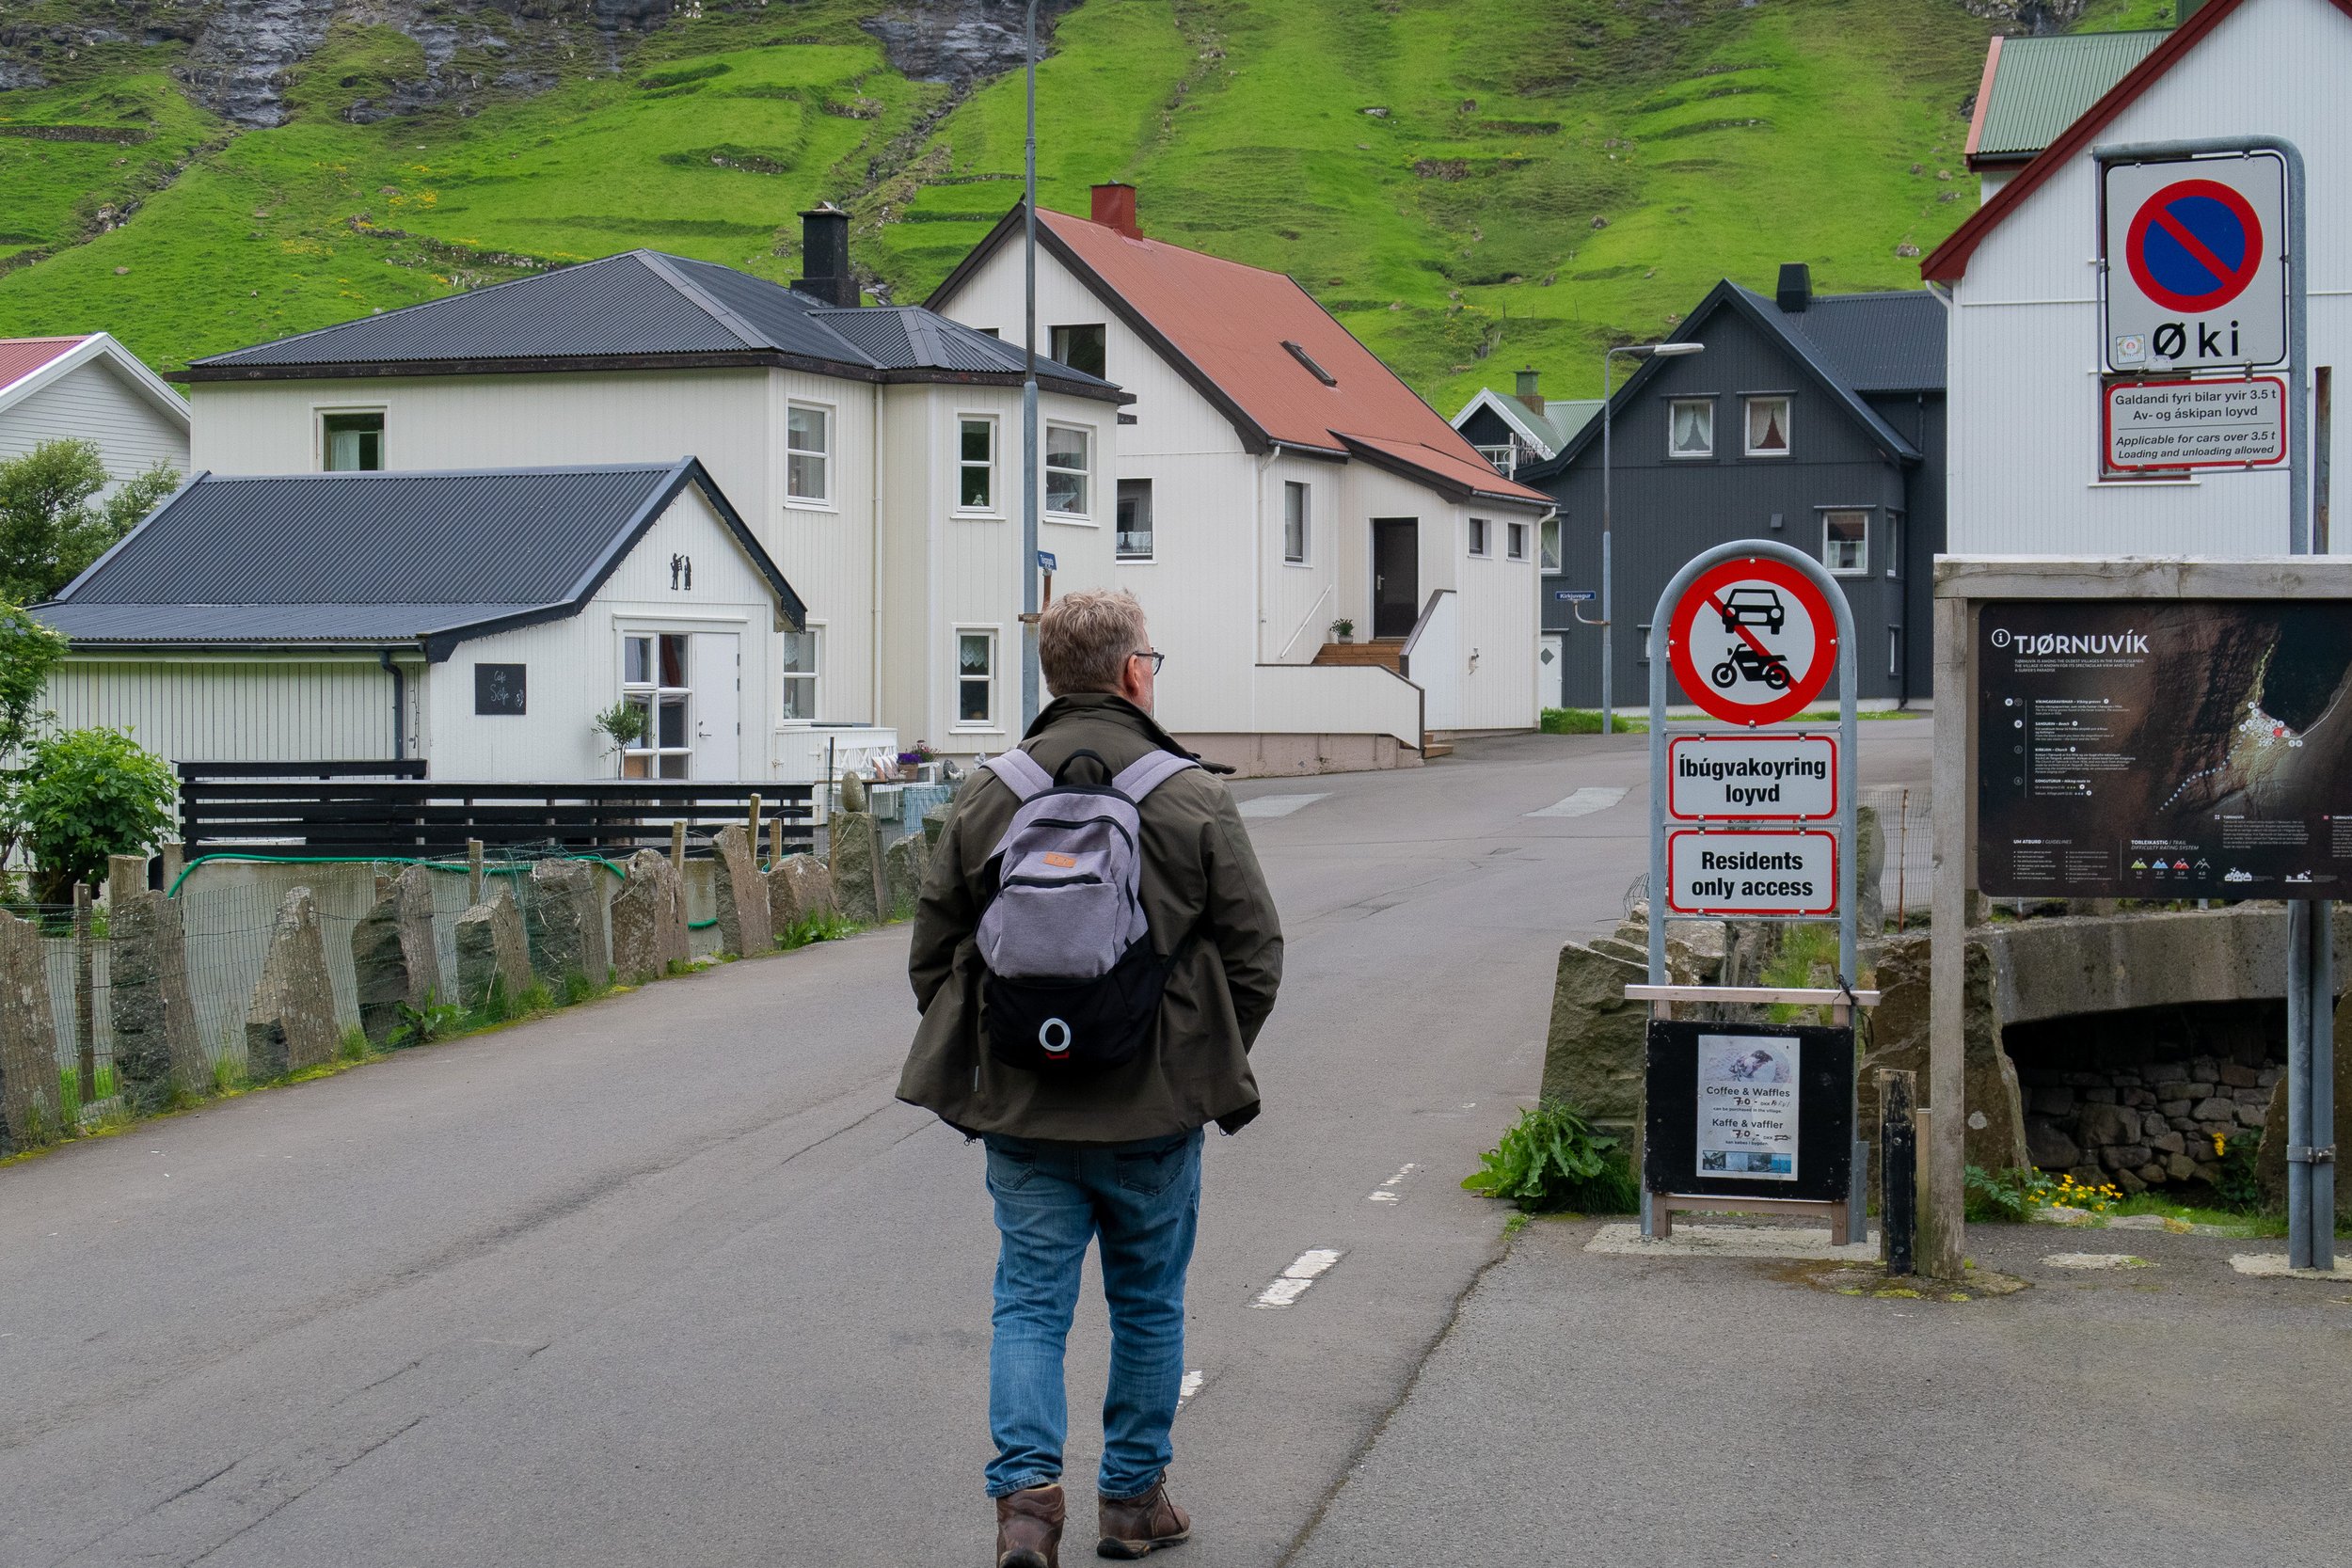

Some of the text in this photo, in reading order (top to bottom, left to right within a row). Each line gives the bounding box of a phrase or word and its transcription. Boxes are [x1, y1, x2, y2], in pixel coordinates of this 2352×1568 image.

[2153, 320, 2240, 360] Øki
[2116, 389, 2276, 405] Galdandi fyri bilar yvir 3.5 t
[2133, 407, 2257, 421] Av- og áskipan loyvd
[2116, 431, 2275, 446] Applicable for cars over 3.5 t
[2118, 445, 2274, 459] Loading and unloading allowed
[2014, 629, 2149, 656] TJØRNUVÍK
[1679, 754, 1826, 782] Íbúgvakoyring
[1725, 784, 1780, 806] loyvd
[1701, 851, 1803, 871] Residents
[1691, 878, 1813, 900] only access
[1707, 1086, 1739, 1095] Coffee
[1752, 1088, 1790, 1097] Waffles
[1712, 1119, 1738, 1127] Kaffe
[1751, 1121, 1783, 1129] vaffler
